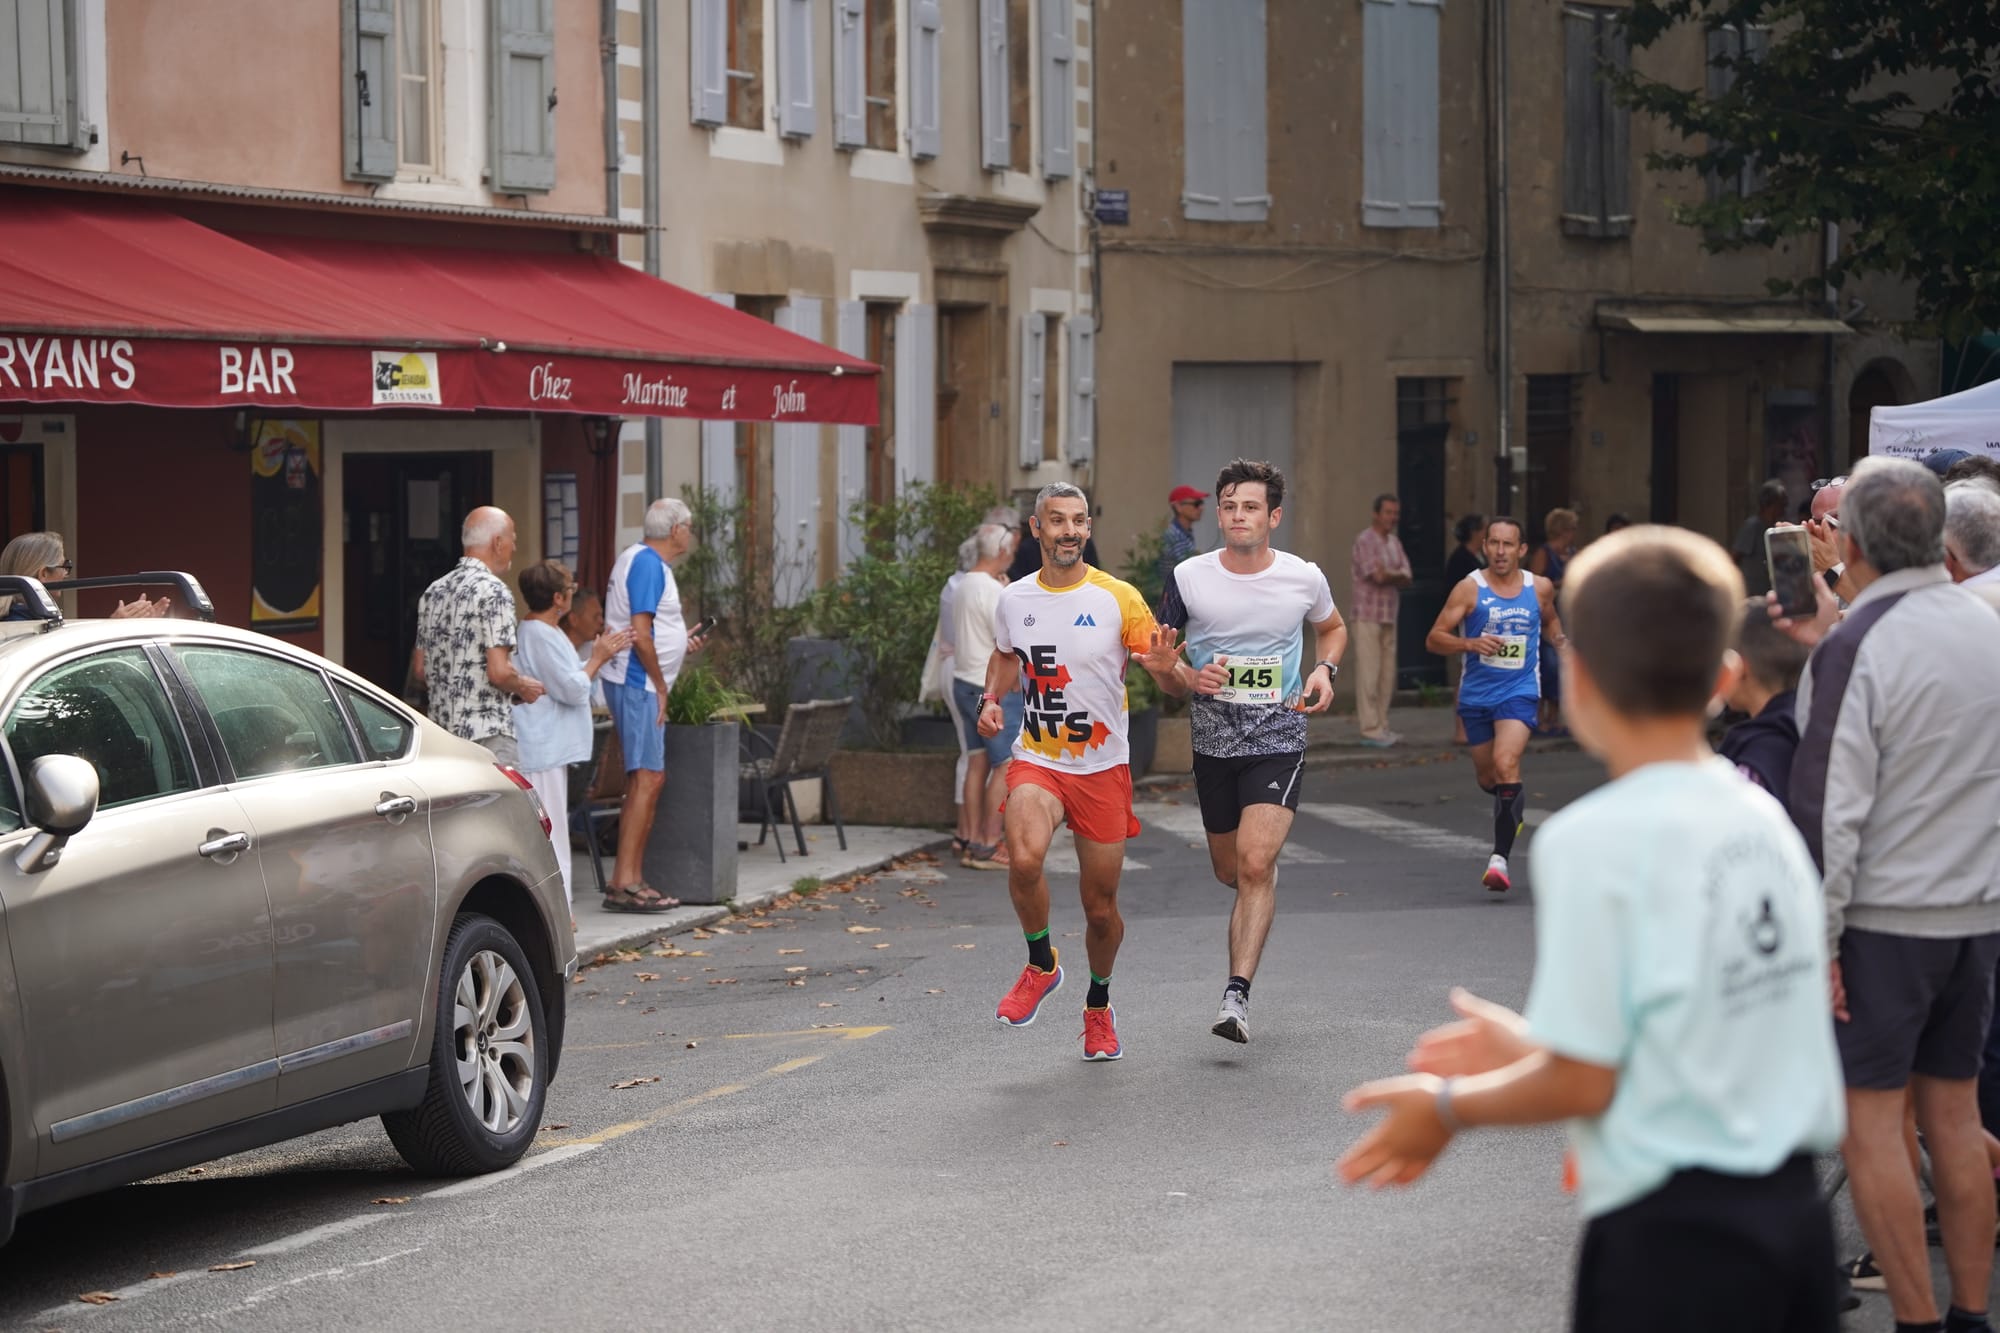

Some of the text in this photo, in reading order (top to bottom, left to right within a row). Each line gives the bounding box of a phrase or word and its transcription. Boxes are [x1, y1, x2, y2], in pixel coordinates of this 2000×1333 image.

[220, 347, 297, 394] BAR
[381, 392, 433, 401] BOISSONS
[529, 362, 806, 419] Chez Martine et John
[1228, 667, 1273, 688] 145
[1023, 711, 1093, 743] NTS
